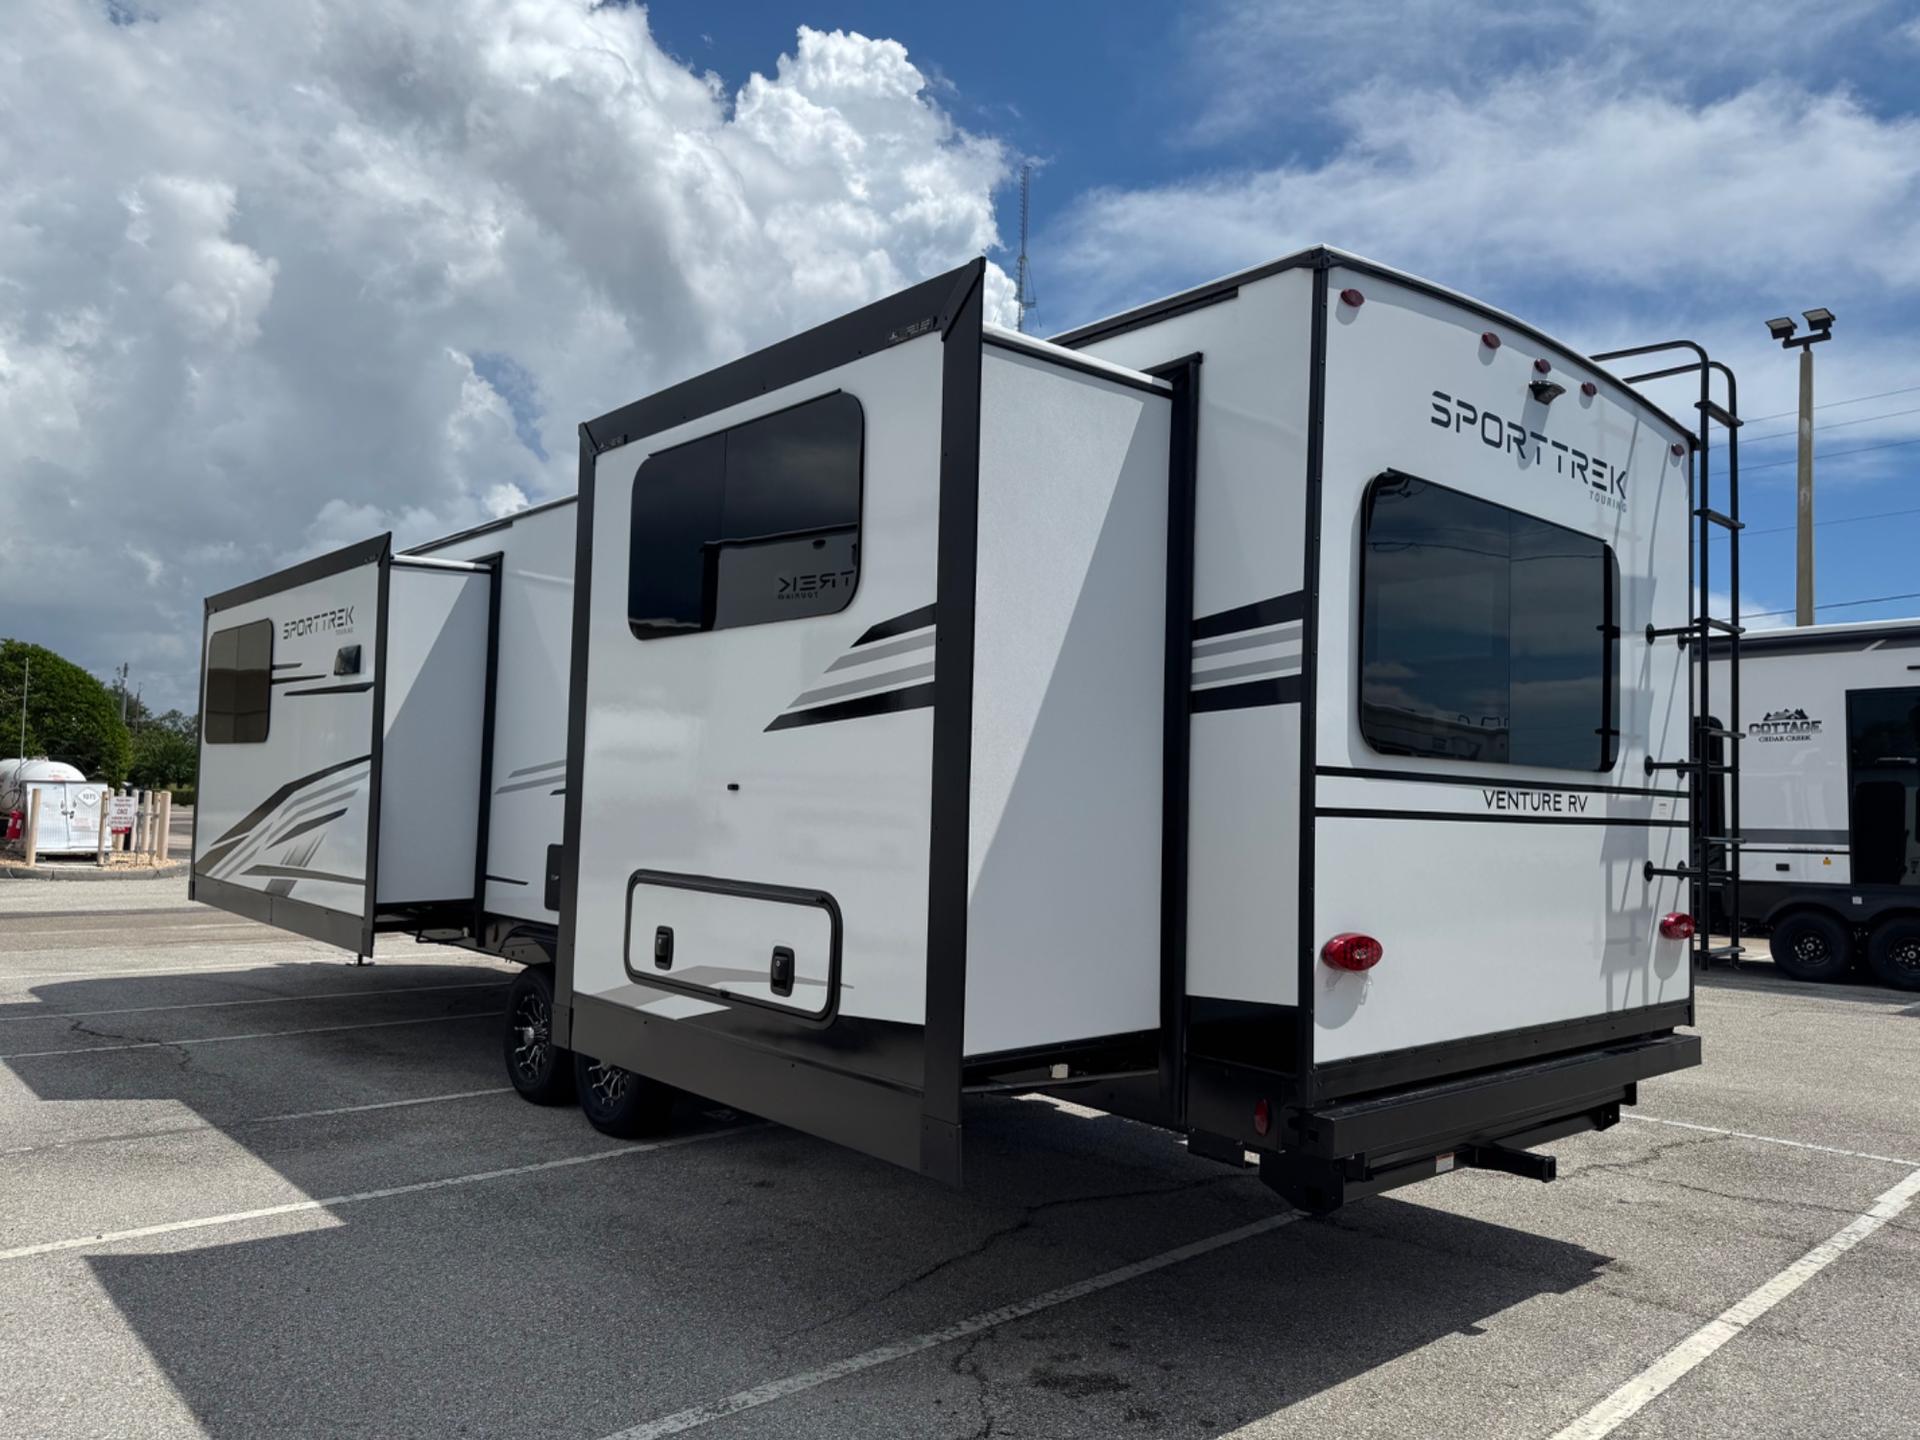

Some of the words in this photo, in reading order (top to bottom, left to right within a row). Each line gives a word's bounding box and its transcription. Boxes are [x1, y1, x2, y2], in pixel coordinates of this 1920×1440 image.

[1431, 390, 1627, 500] SPORTTREK
[1589, 490, 1627, 513] TOURING
[283, 605, 354, 640] SPORTTREK
[1749, 720, 1822, 736] COTTAGE
[1482, 789, 1562, 812] VENTURE
[1567, 795, 1588, 812] RV
